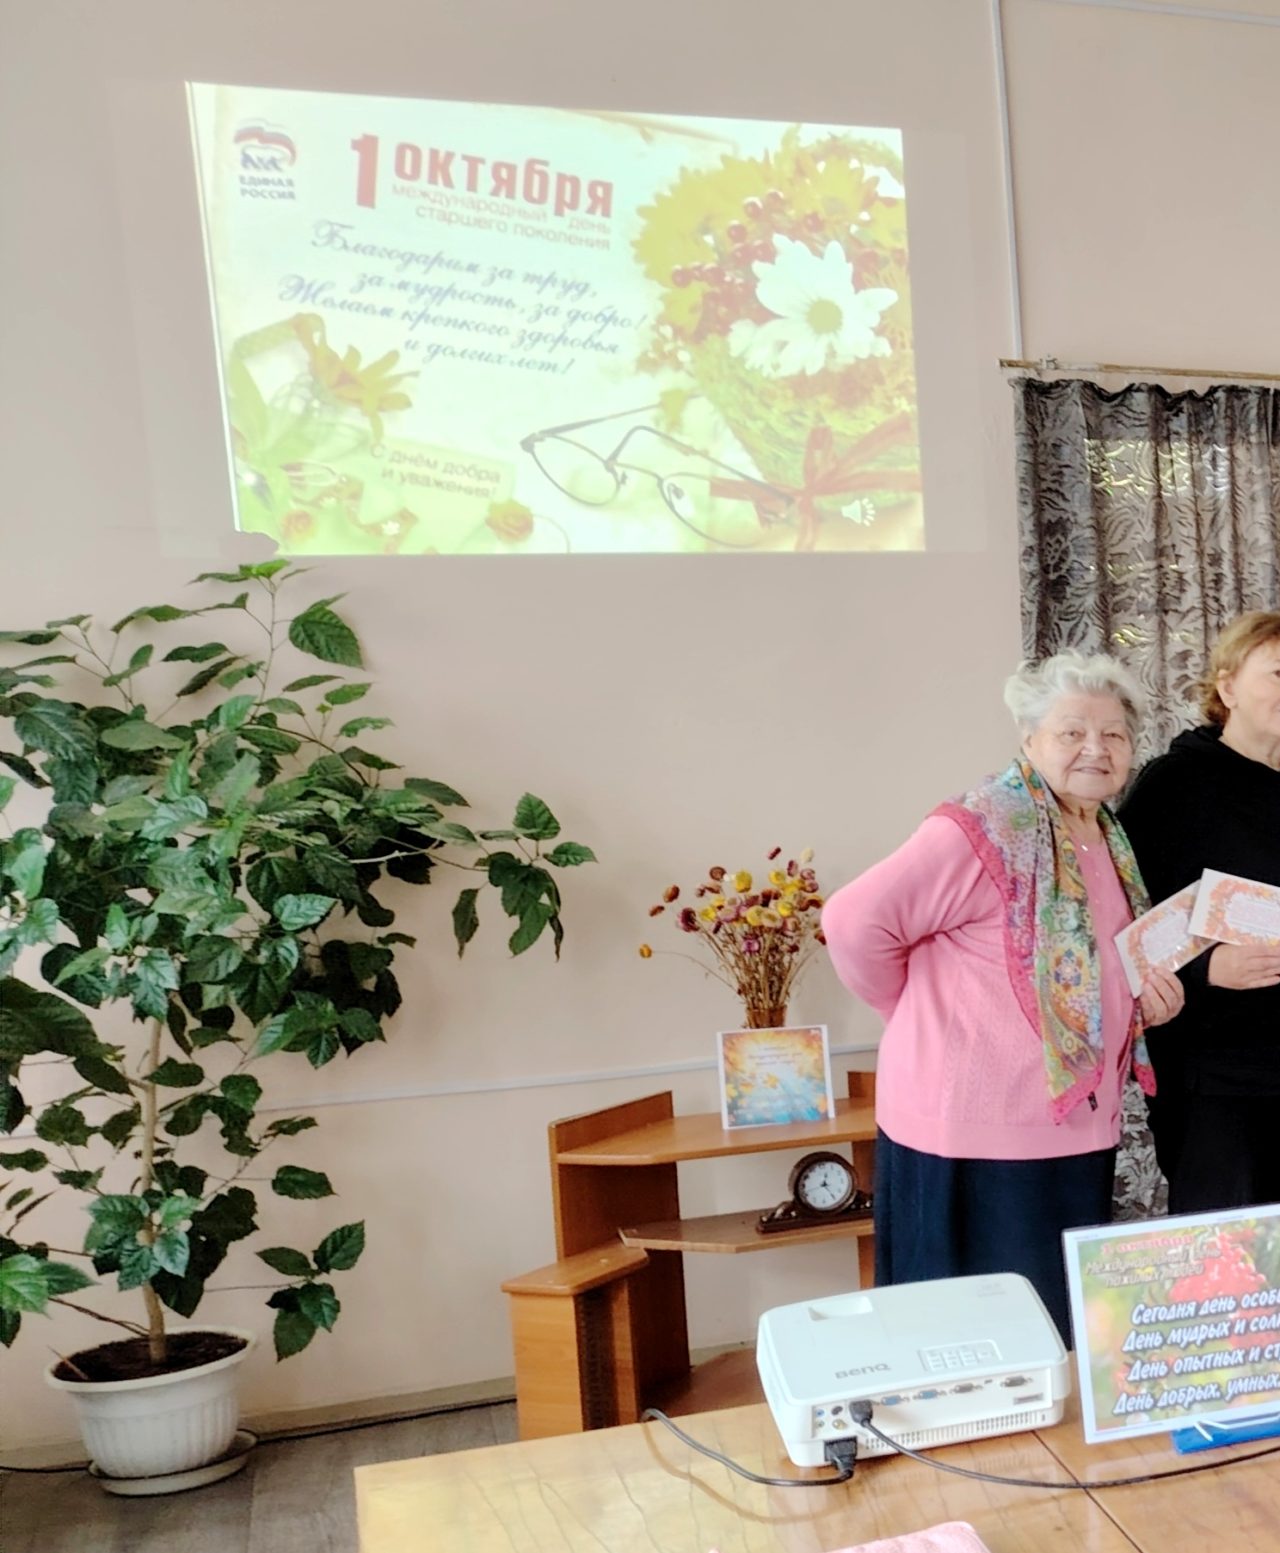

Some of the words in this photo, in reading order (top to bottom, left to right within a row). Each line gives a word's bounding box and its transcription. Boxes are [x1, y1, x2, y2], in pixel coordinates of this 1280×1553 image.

[238, 174, 295, 188] ЕДИНАЯ
[351, 132, 378, 209] 1
[394, 142, 614, 218] октября
[239, 188, 297, 201] РОССИЯ
[392, 184, 548, 223] международный
[568, 217, 612, 236] день
[415, 204, 509, 235] старшего
[513, 222, 611, 252] поколения
[311, 218, 480, 275] Благодарим
[481, 265, 515, 288] за
[522, 270, 598, 303] труд,
[278, 273, 395, 319] Желаем
[400, 306, 511, 337] крепкого
[510, 328, 620, 354] здоровья
[350, 272, 385, 295] за
[389, 281, 526, 314] мудрость,
[527, 302, 561, 324] за
[565, 304, 649, 334] добро!
[403, 338, 421, 352] и
[421, 341, 506, 366] долгих
[370, 442, 386, 459] С
[442, 461, 501, 484] добра
[381, 467, 394, 479] и
[1131, 1301, 1197, 1326] Сегодня
[1197, 1295, 1237, 1317] день
[1121, 1329, 1164, 1352] День
[1165, 1320, 1231, 1349] мудрых
[1233, 1318, 1247, 1335] и
[834, 1363, 892, 1380] BenQ
[1126, 1359, 1169, 1382] День
[1172, 1348, 1245, 1375] опытных
[1247, 1345, 1262, 1363] и
[1112, 1391, 1155, 1415] День
